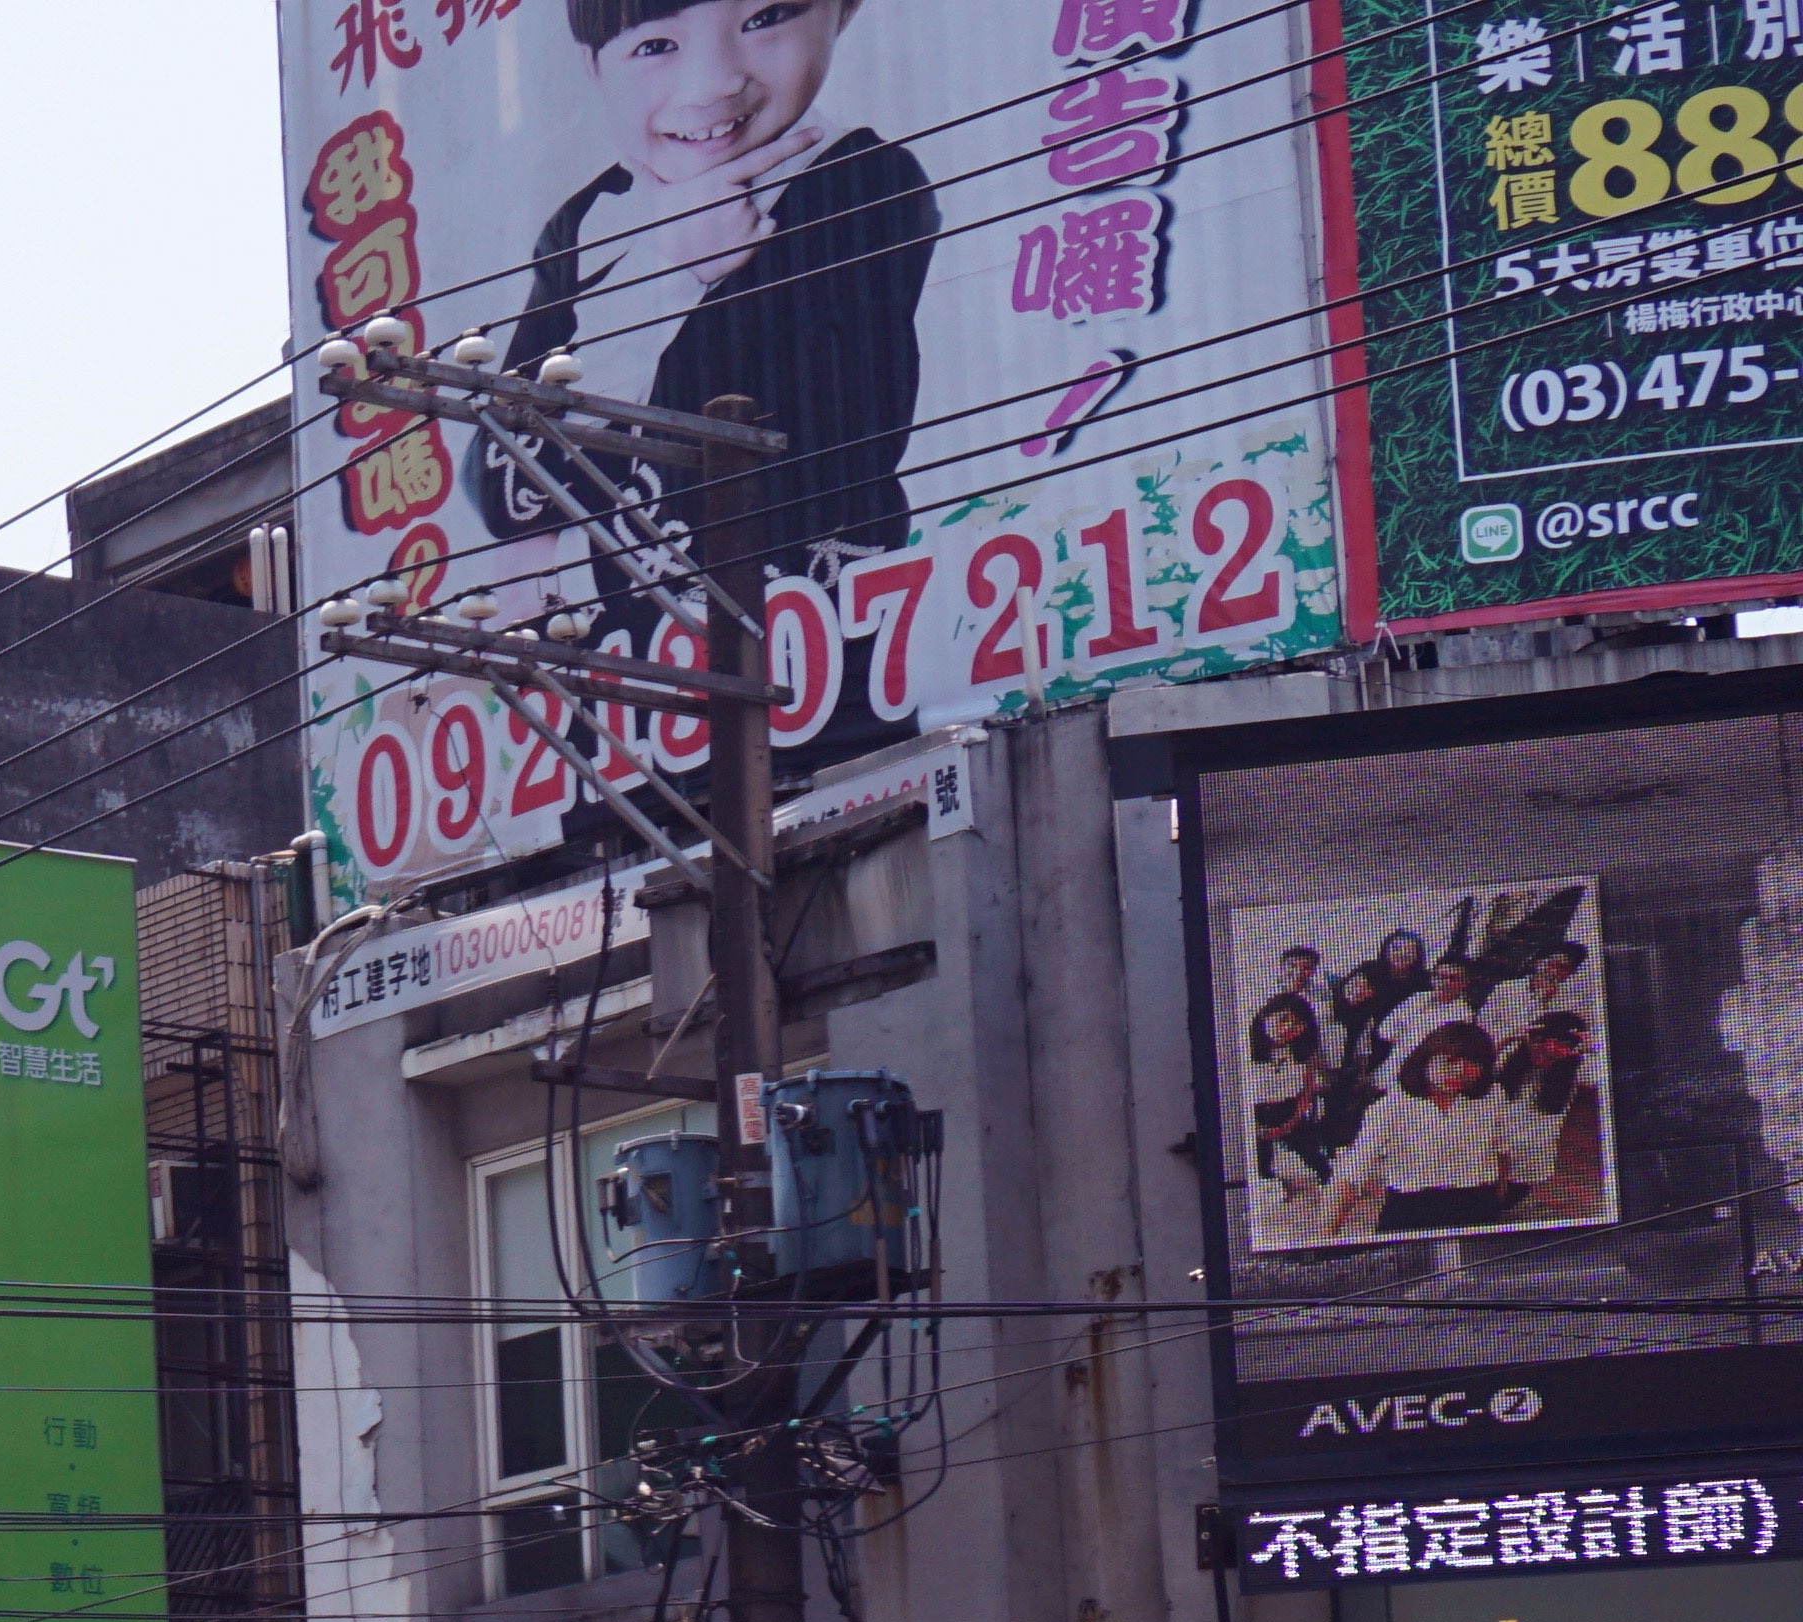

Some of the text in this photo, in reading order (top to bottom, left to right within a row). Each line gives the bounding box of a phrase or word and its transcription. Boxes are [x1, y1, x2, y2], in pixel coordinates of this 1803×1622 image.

[1476, 17, 1555, 96] 樂
[1608, 3, 1686, 77] 活
[1486, 110, 1560, 231] 總價
[1569, 85, 1803, 218] 88
[1476, 522, 1510, 538] LINE
[1536, 492, 1700, 549] @srcc
